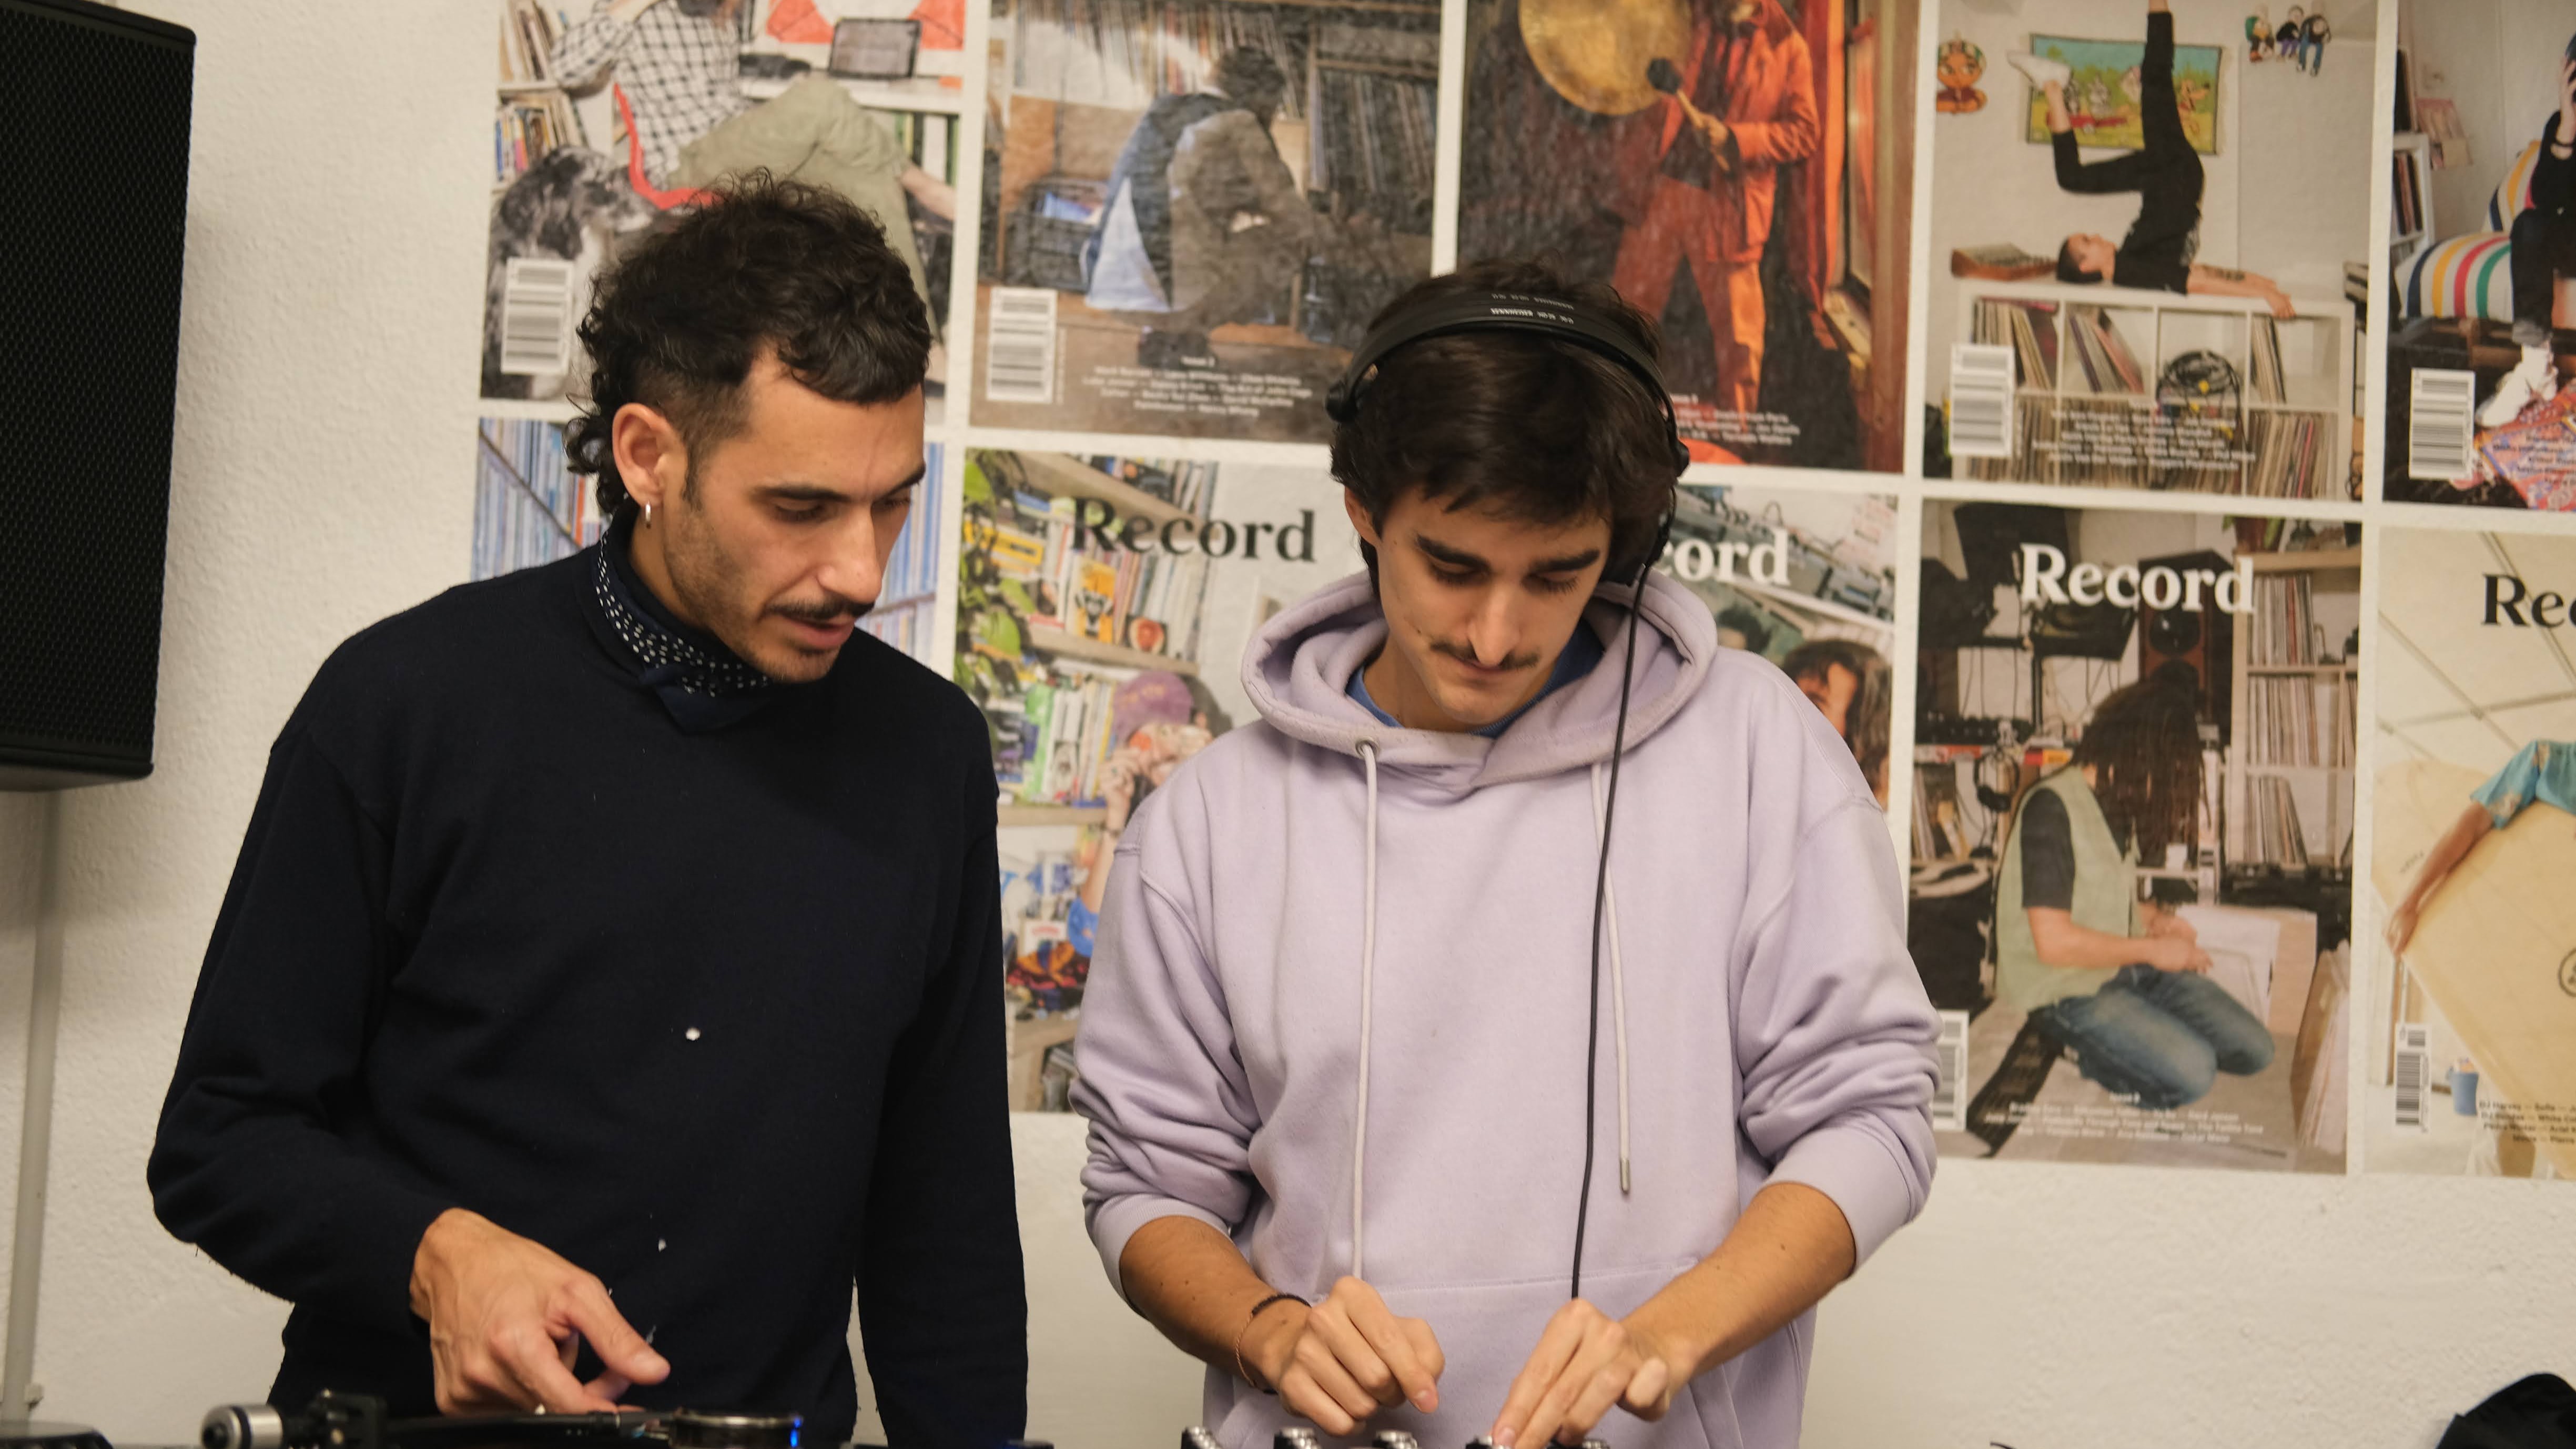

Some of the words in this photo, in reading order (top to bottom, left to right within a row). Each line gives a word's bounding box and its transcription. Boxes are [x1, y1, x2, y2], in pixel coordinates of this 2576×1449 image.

[1071, 495, 1317, 563] Record
[1662, 526, 1790, 586] ord
[2020, 542, 2255, 614] Record
[2480, 573, 2576, 629] Re
